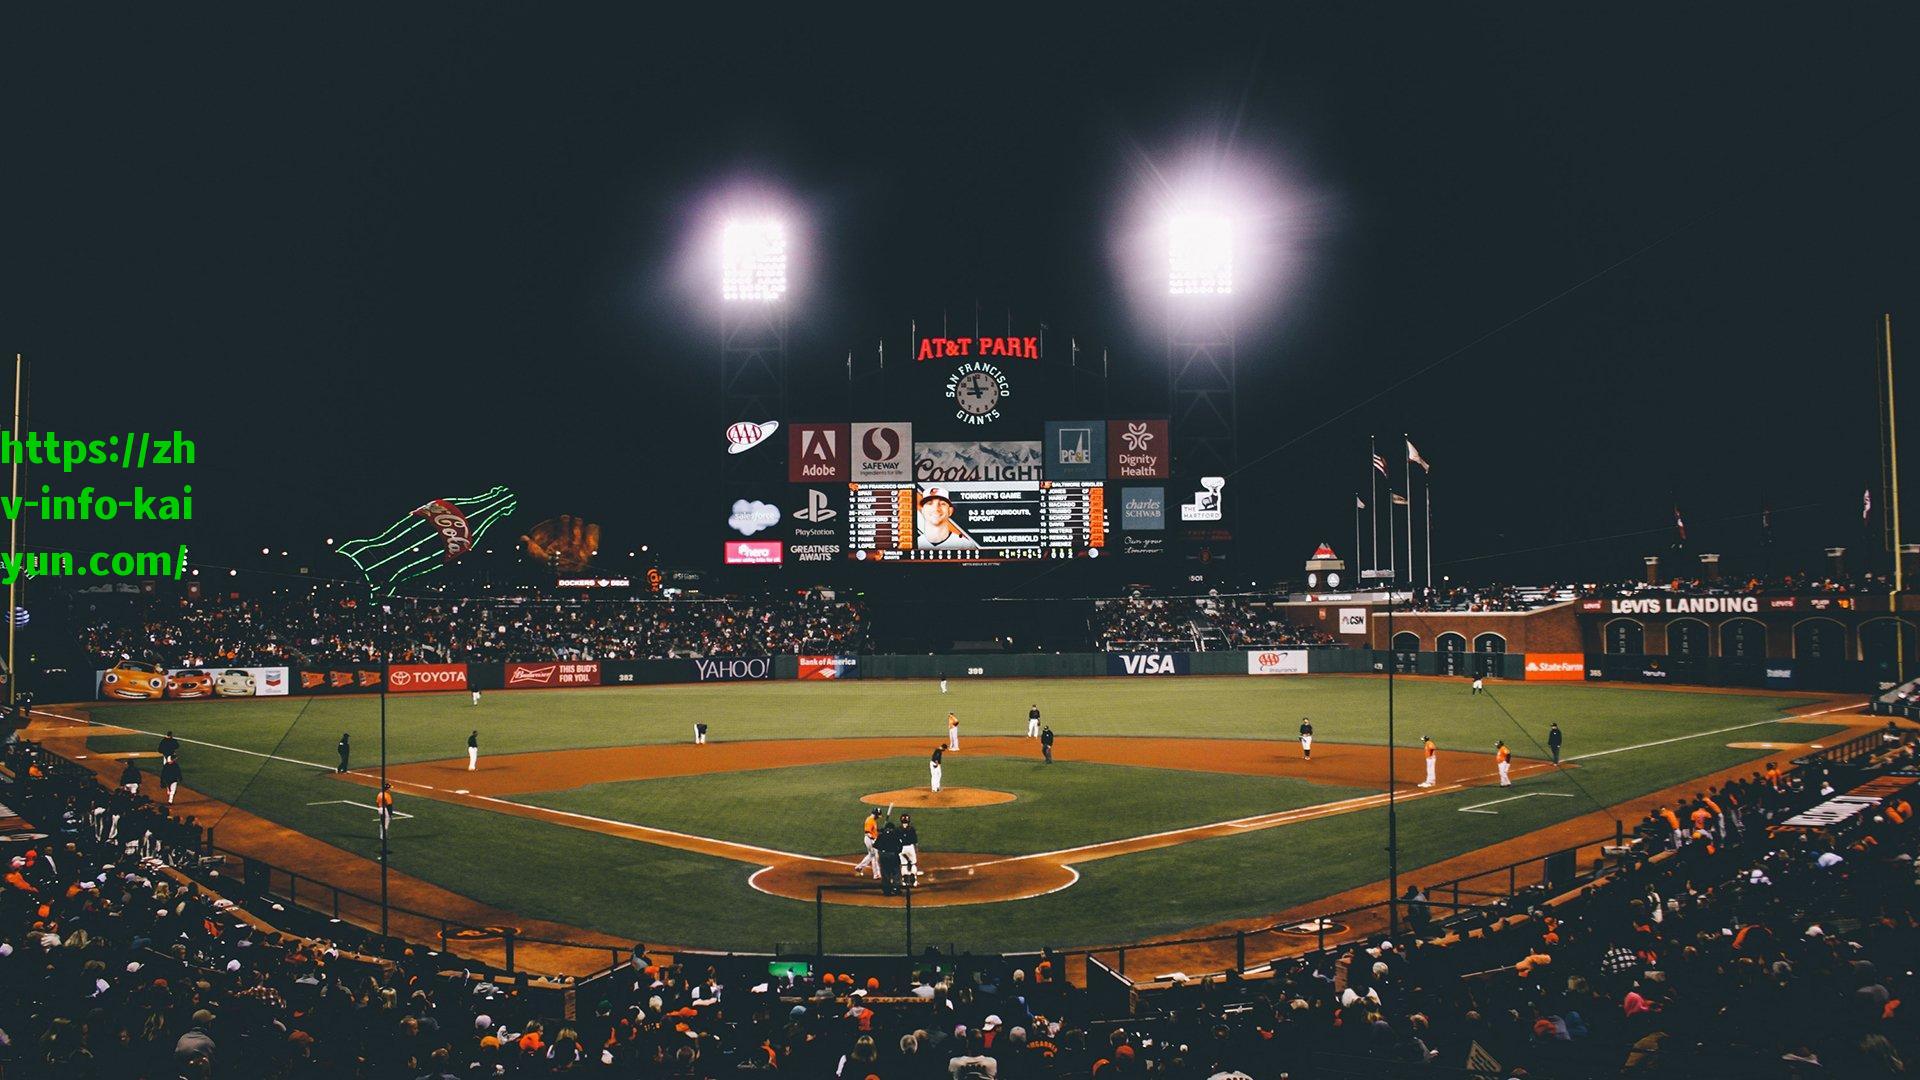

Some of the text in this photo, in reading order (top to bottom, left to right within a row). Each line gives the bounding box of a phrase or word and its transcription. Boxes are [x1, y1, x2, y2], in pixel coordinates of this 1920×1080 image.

[918, 337, 1038, 360] AT&T PARK
[945, 361, 1010, 398] SAN FRANCISCO
[956, 409, 1001, 425] GIANTS
[862, 462, 900, 470] SAFEWAY
[1119, 454, 1157, 466] Dignity
[802, 464, 836, 476] Adobe
[916, 458, 1043, 480] Coors LIGHT
[1121, 467, 1156, 476] Health
[1125, 499, 1160, 510] charles
[1125, 510, 1161, 518] SCHWAB
[434, 514, 470, 552] Cola
[795, 528, 835, 537] PlayStation
[790, 545, 840, 553] GREATNESS
[799, 553, 832, 561] AWAITS
[1666, 597, 1758, 613] LANDING
[1350, 616, 1364, 624] CSN
[1119, 654, 1176, 674] VISA
[1258, 654, 1280, 666] AAA
[516, 668, 552, 678] Budweiser
[560, 664, 598, 673] THIS BUD'S
[695, 658, 770, 681] YAHOO!
[412, 670, 466, 683] TOYOTA
[560, 674, 590, 682] FOR YOU.
